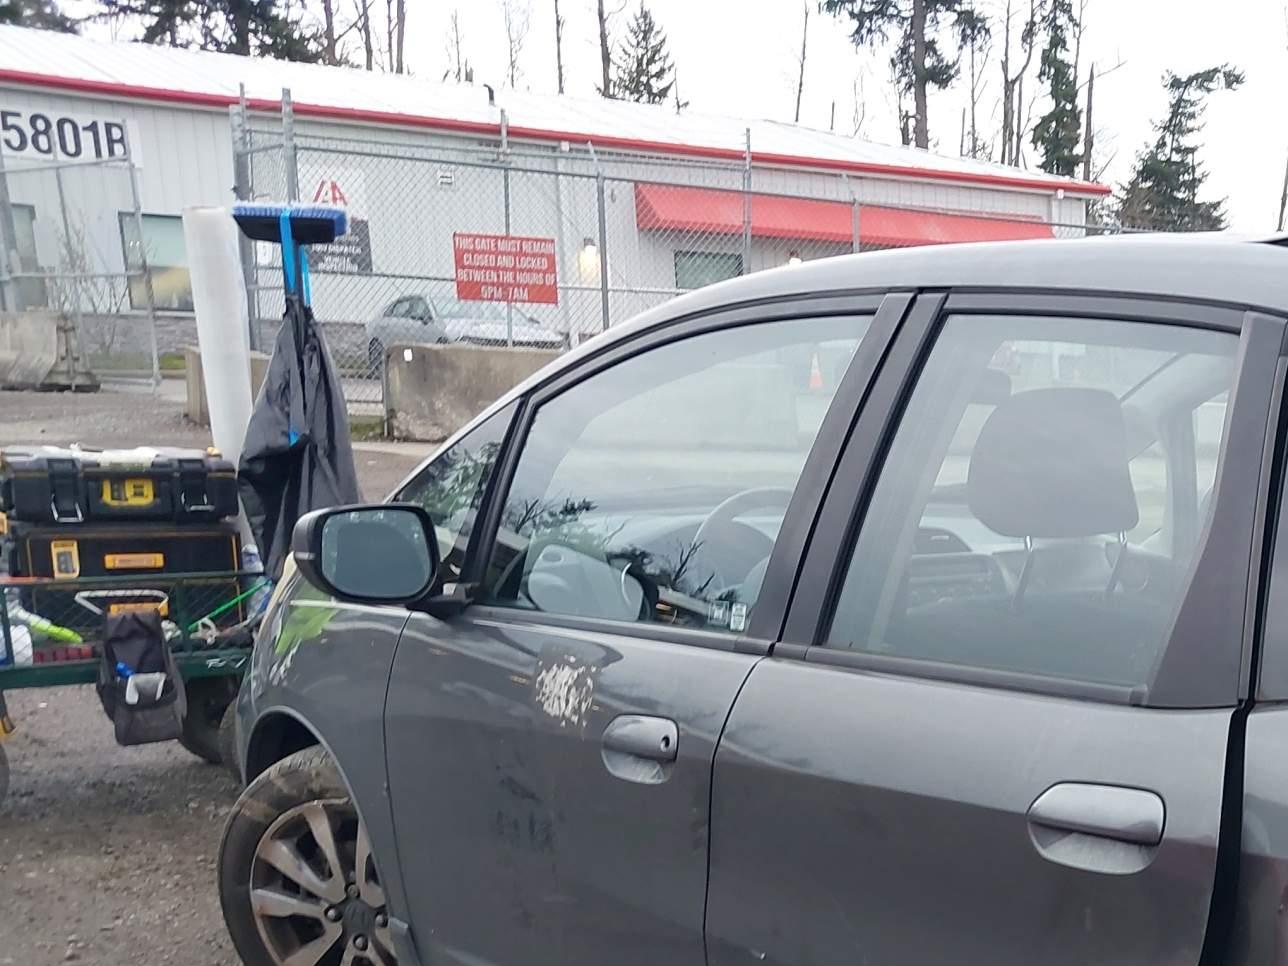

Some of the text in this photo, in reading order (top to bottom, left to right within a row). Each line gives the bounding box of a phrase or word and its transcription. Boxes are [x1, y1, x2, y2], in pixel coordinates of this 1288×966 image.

[475, 237, 497, 251] GATE
[498, 239, 521, 252] MUST
[522, 240, 554, 254] REMAIN
[463, 253, 548, 270] CLOSED AND LOCKED
[457, 268, 556, 286] BETWEEN THE HOURS OF
